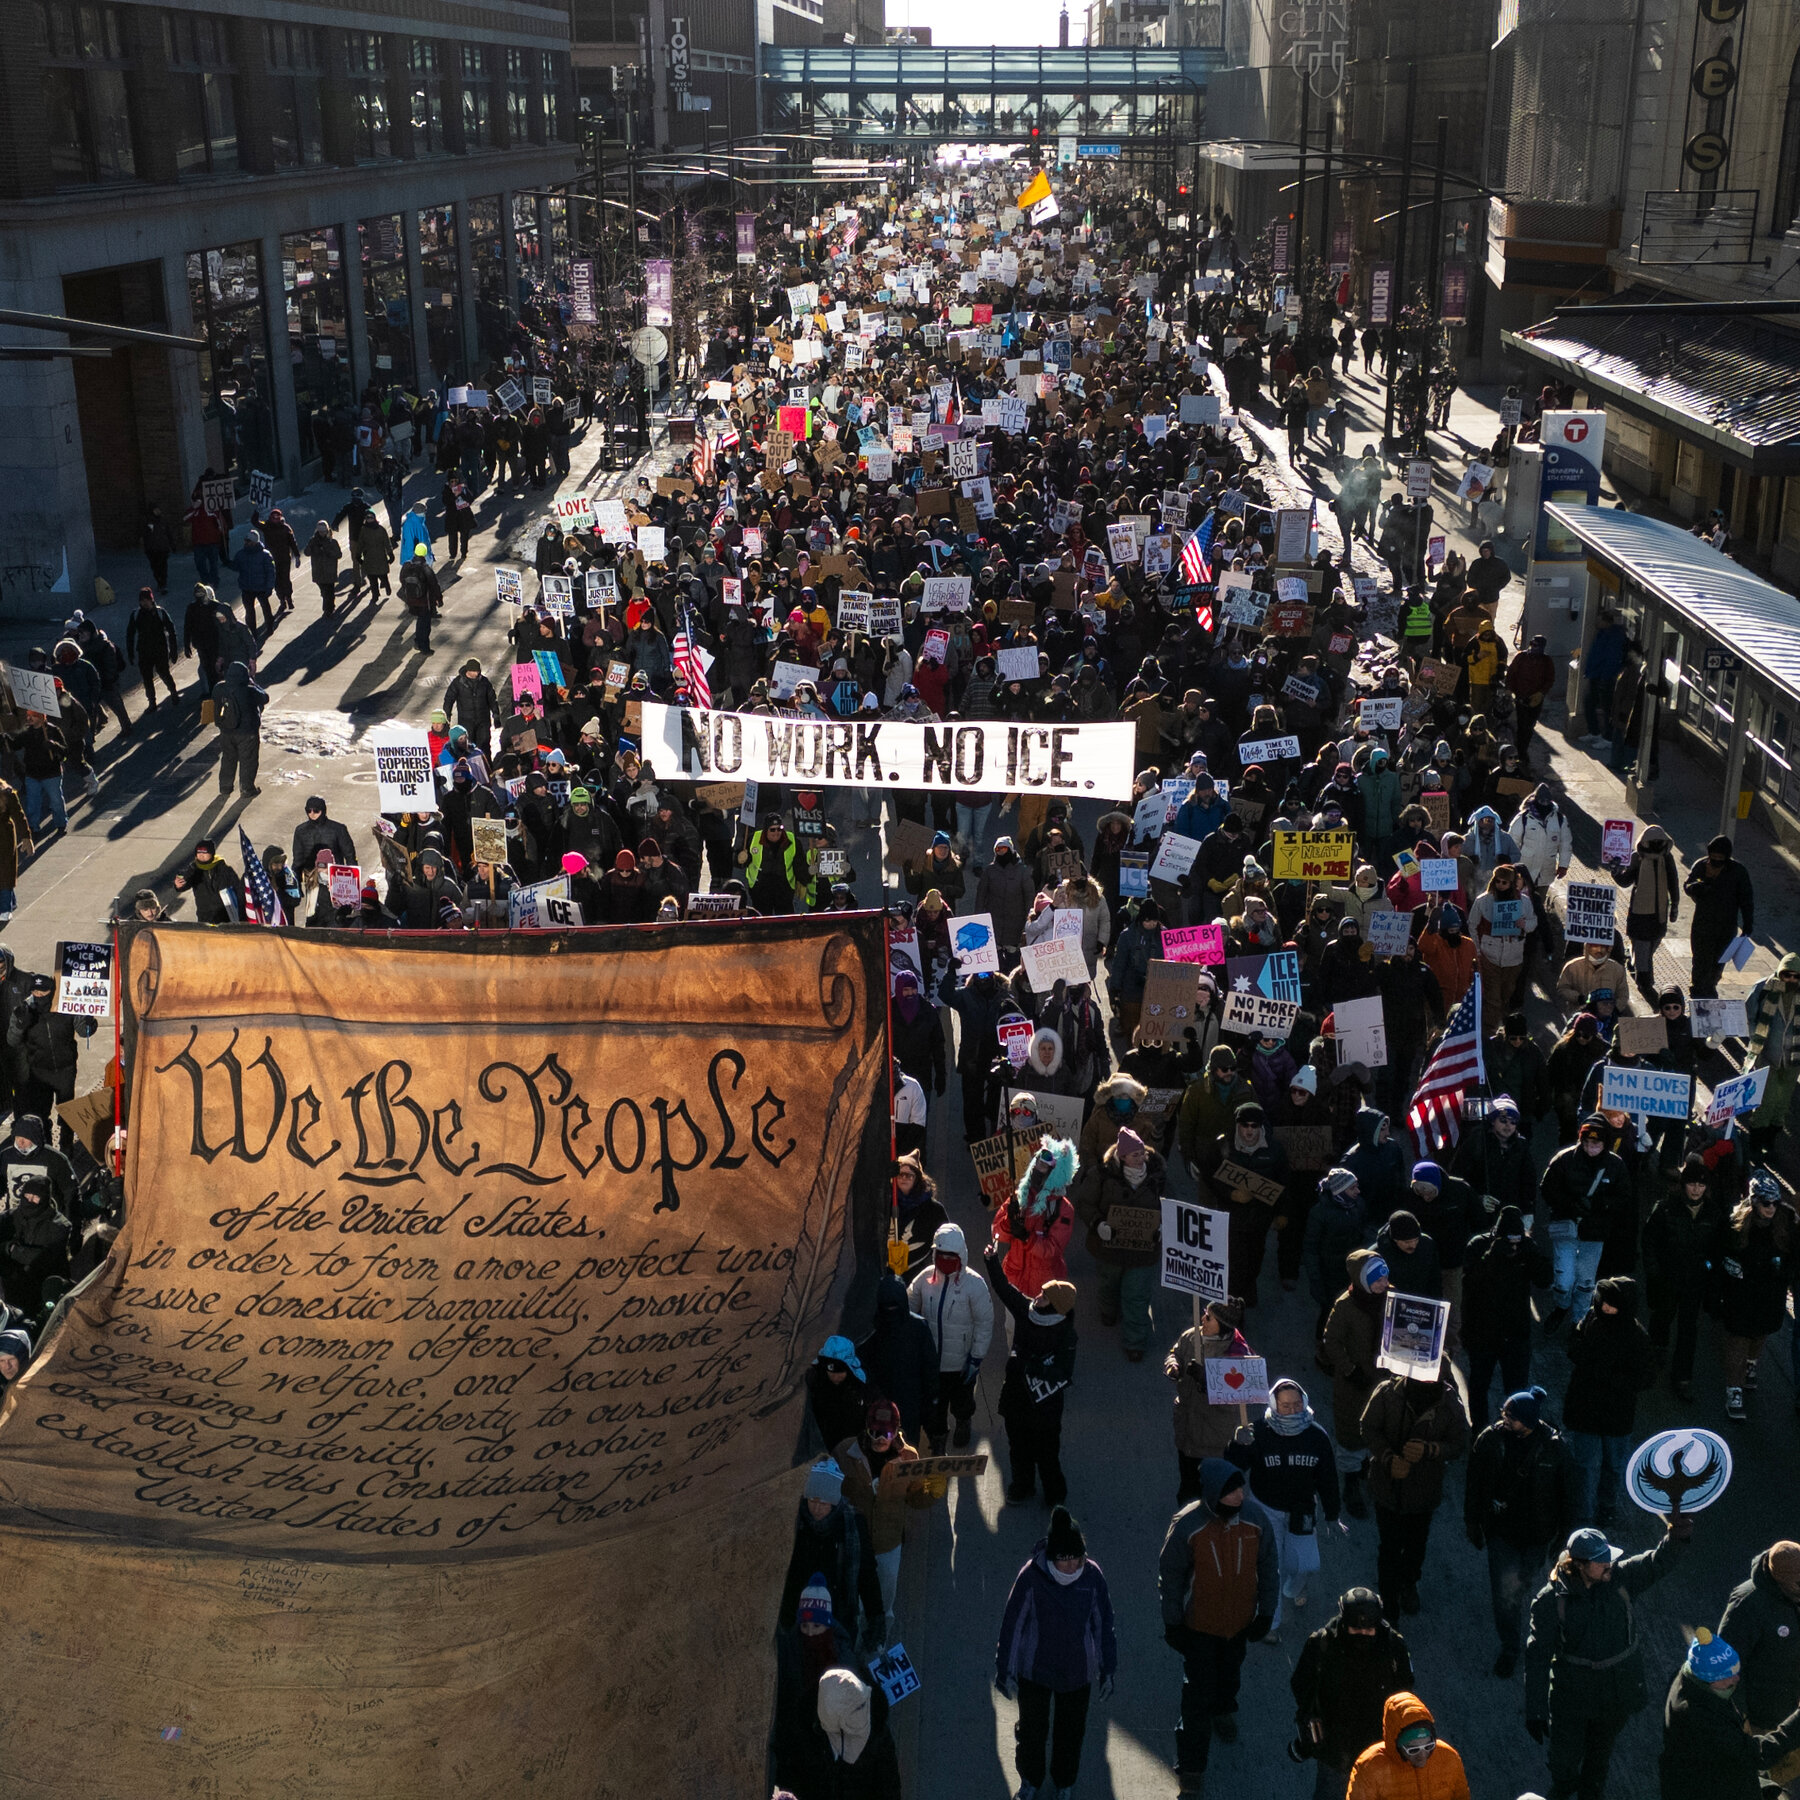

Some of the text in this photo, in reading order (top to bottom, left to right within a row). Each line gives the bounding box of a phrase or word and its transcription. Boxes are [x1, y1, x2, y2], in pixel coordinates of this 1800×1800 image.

[1273, 225, 1289, 270] BRIGHTER
[573, 262, 590, 322] BRIGHTER
[1371, 270, 1390, 323] BOLDER
[847, 344, 862, 355] STOP
[793, 388, 805, 398] ICE
[1001, 398, 1026, 412] FUCK
[1001, 414, 1024, 429] ICE
[768, 432, 789, 445] ICE
[1567, 424, 1586, 440] T
[770, 445, 788, 456] OUT
[953, 441, 973, 455] ICE
[954, 454, 973, 467] OUT
[951, 464, 974, 478] NOW
[1415, 466, 1426, 474] NO
[205, 484, 233, 498] ICE
[252, 477, 273, 492] ICE
[207, 497, 234, 511] OUT
[251, 490, 271, 507] OUT
[557, 498, 590, 517] LOVE
[588, 588, 614, 599] JUSTICE
[929, 583, 945, 594] ICE
[498, 593, 521, 606] ICE
[546, 594, 571, 604] JUSTICE
[843, 601, 866, 610] STANDS
[840, 612, 868, 622] AGAINST
[872, 609, 896, 617] STANDS
[838, 621, 867, 632] ICE
[871, 618, 900, 628] AGAINST
[871, 627, 900, 636] ICE
[10, 669, 56, 694] FUCK
[517, 674, 535, 684] FAN
[608, 673, 626, 683] OUT
[1285, 685, 1314, 702] TRUMP
[1290, 679, 1315, 696] DUMP
[21, 691, 55, 712] ICE
[376, 746, 430, 757] MINNESOTA
[682, 710, 1096, 790] NO WORK. NO ICE.
[1265, 739, 1294, 750] TIME TO
[1267, 748, 1288, 759] GTFO
[377, 756, 430, 770] GOPHERS
[380, 770, 431, 783] AGAINST
[399, 783, 418, 796] ICE
[794, 807, 823, 821] MELTS
[799, 822, 823, 834] ICE
[1283, 832, 1354, 845] I LIKE MY
[1301, 845, 1342, 859] NEAT
[1421, 859, 1455, 869] LOONS
[1421, 868, 1457, 877] TOGETHER
[1424, 876, 1457, 888] STRONG
[1568, 884, 1615, 901] GENERAL
[546, 898, 575, 926] ICE
[1567, 897, 1615, 915] STRIKE:
[1567, 911, 1614, 927] THE PATH TO
[1163, 927, 1218, 947] BUILT BY
[1567, 924, 1613, 940] JUSTICE
[65, 943, 109, 956] TSOV TOM
[78, 952, 94, 961] ICE
[65, 958, 107, 971] MOB PIM
[976, 951, 995, 965] ICE
[1269, 952, 1298, 981] ICE
[1271, 980, 1299, 1004] OUT
[62, 1002, 106, 1015] FUCK OFF
[1234, 995, 1297, 1017] NO MORE
[1229, 1009, 1293, 1030] MN ICE!
[1608, 1072, 1689, 1096] MN LOVES
[1717, 1082, 1739, 1099] LEAVE
[1607, 1092, 1689, 1117] IMMIGRANTS
[1716, 1099, 1726, 1109] US
[154, 1024, 797, 1215] We the People
[1013, 1123, 1054, 1148] TRUMP
[976, 1153, 1006, 1175] THAT
[209, 1189, 606, 1242] of the United States,
[1176, 1205, 1213, 1252] ICE
[127, 1231, 707, 1296] in order to form perfect
[1166, 1247, 1225, 1272] OUT OF
[1166, 1257, 1224, 1290] MINNESOTA
[234, 1280, 396, 1322] domestic
[385, 1284, 590, 1336] tranquility,
[595, 1277, 764, 1333] provide
[164, 1318, 246, 1354] the
[258, 1333, 394, 1362] common
[407, 1323, 561, 1378] defence,
[560, 1317, 724, 1370] promote
[69, 1342, 753, 1409] general welfare, and secure the
[1206, 1360, 1264, 1376] WE KEEP
[1208, 1375, 1223, 1391] US
[64, 1361, 769, 1446] Blessings of Liberty to ourselves
[48, 1382, 671, 1479] and our posterity, do ordain
[35, 1412, 665, 1502] establish this Constitution for
[1264, 1455, 1281, 1467] LOS
[899, 1455, 985, 1479] ICE OUT!
[134, 1464, 695, 1550] United States of America
[891, 1671, 920, 1699] GO
